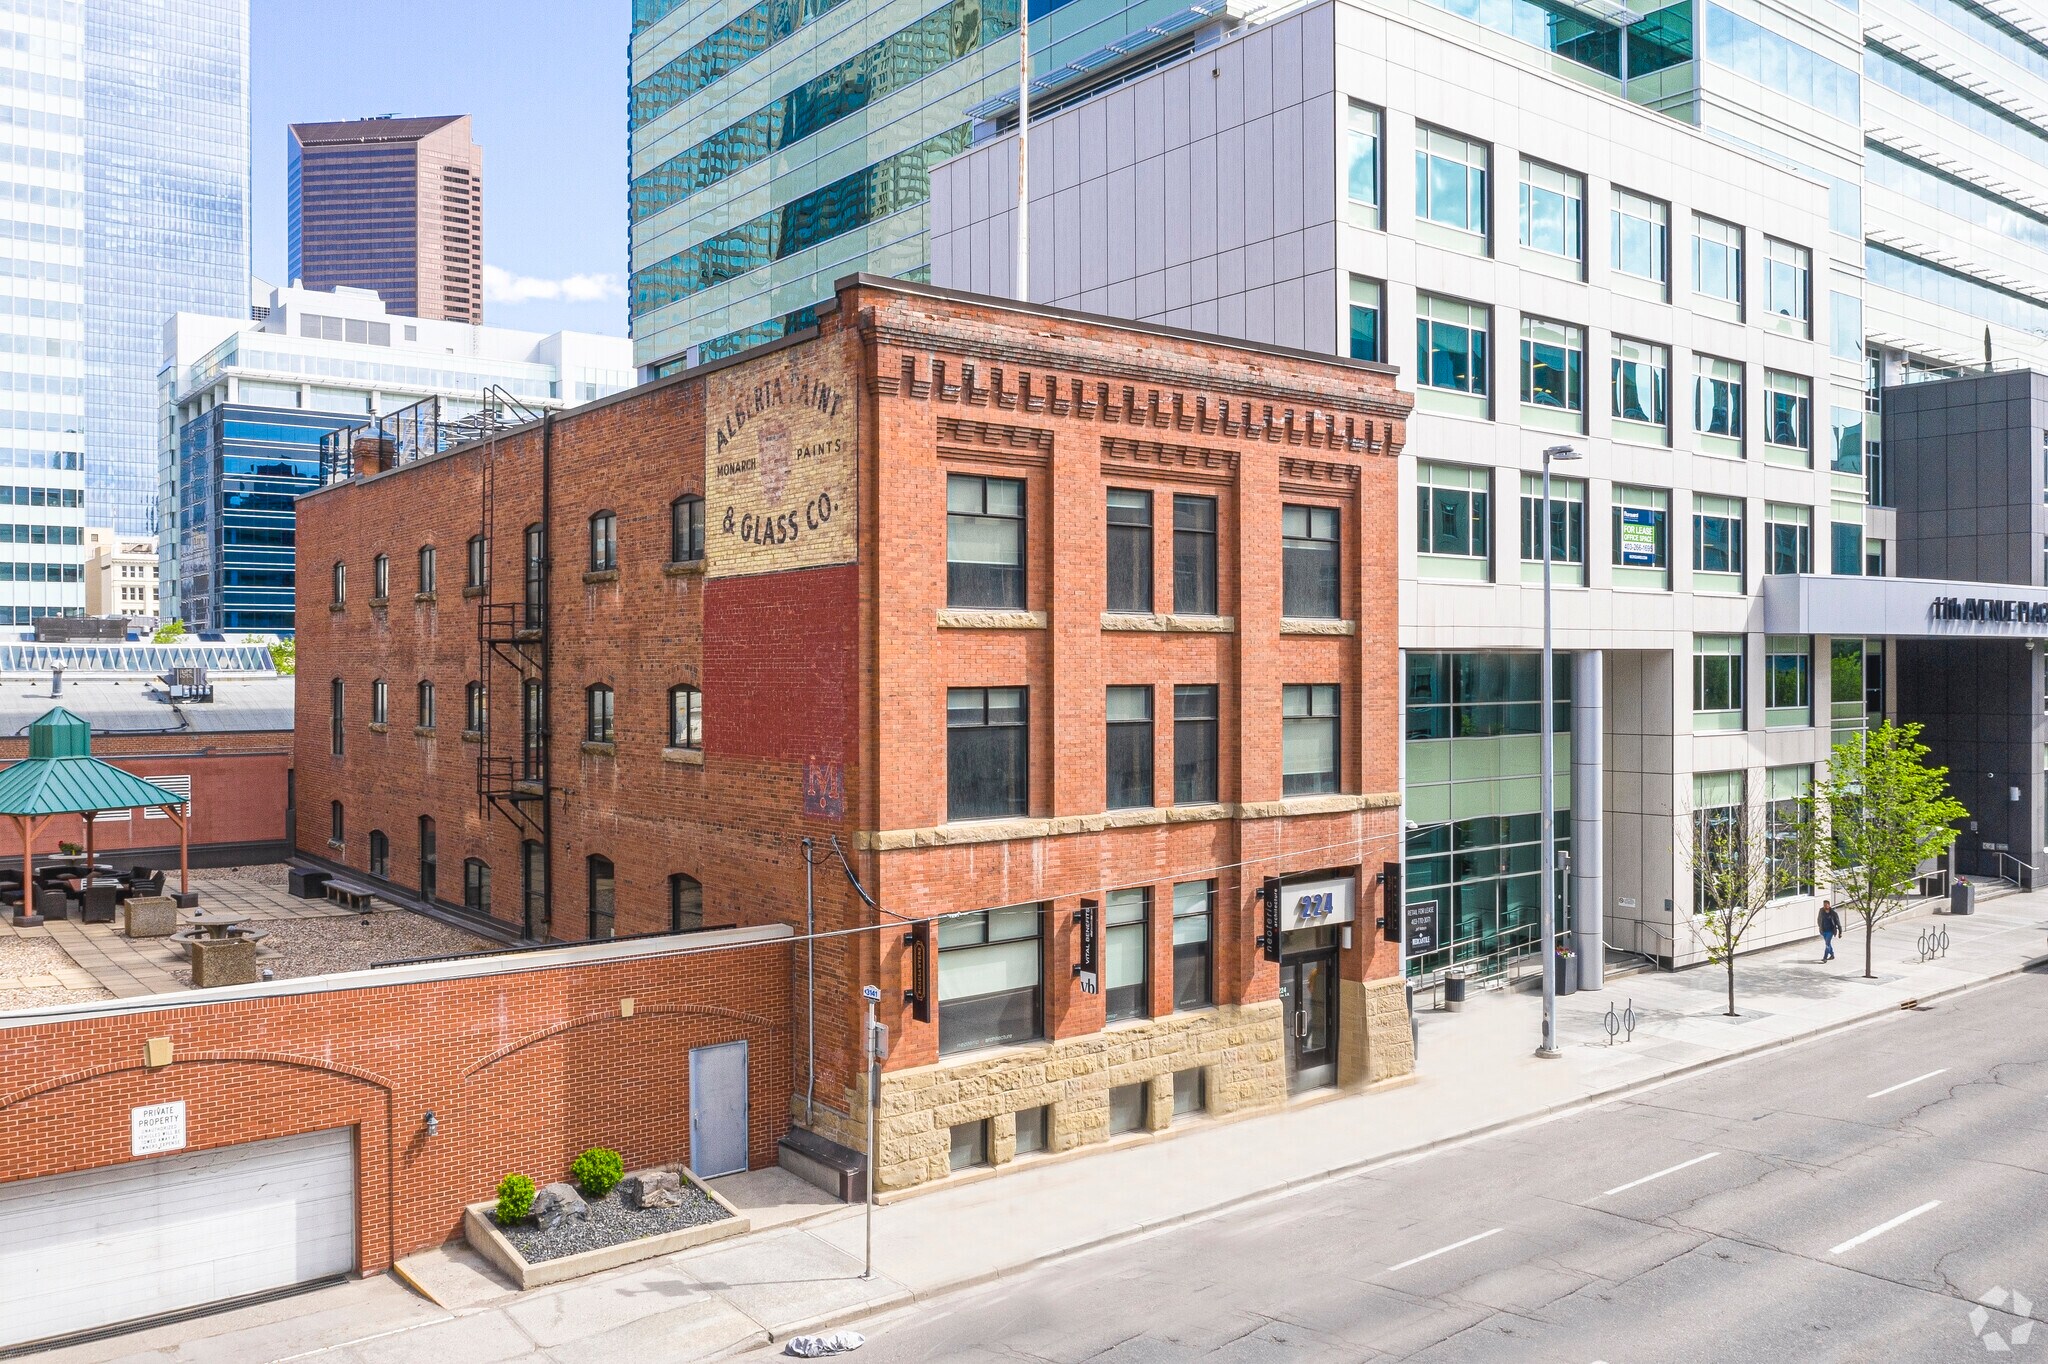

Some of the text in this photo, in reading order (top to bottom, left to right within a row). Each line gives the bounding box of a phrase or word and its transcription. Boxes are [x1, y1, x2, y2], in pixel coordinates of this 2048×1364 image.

[717, 439, 841, 477] MONARCH PAINTS
[723, 492, 839, 545] & GLASS CO.
[1624, 525, 1653, 535] FOR LEASE
[1640, 535, 1653, 543] SPACE
[1932, 597, 1961, 619] 11th
[1962, 598, 2017, 622] AVENUE
[1302, 892, 1333, 918] 224
[1425, 906, 1434, 914] LEASE
[1081, 978, 1095, 995] vb
[143, 1106, 174, 1117] PRIVATE
[138, 1115, 179, 1127] PROPERTY
